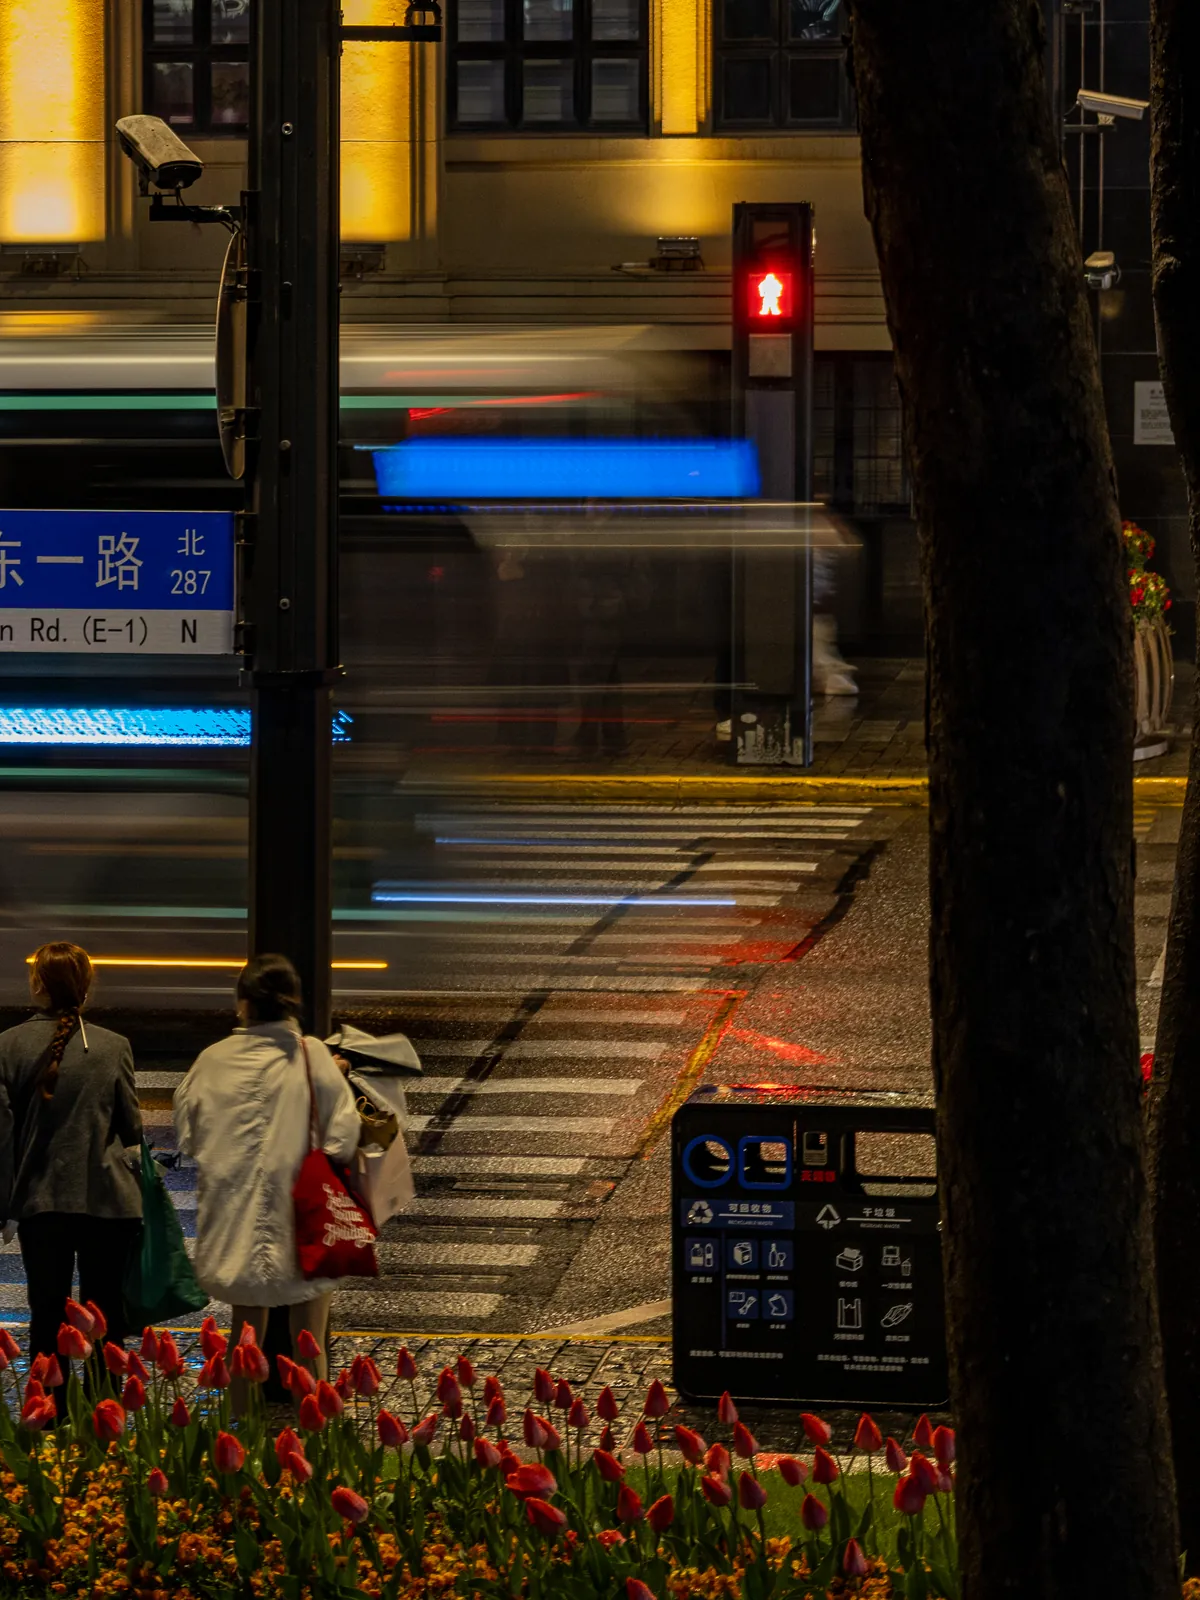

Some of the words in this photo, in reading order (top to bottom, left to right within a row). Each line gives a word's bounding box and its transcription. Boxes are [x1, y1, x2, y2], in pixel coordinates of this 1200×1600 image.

[176, 529, 206, 556] 北
[170, 569, 212, 595] 287
[30, 617, 68, 642] Rd.
[83, 615, 148, 646] (E-1)
[180, 618, 197, 643] N
